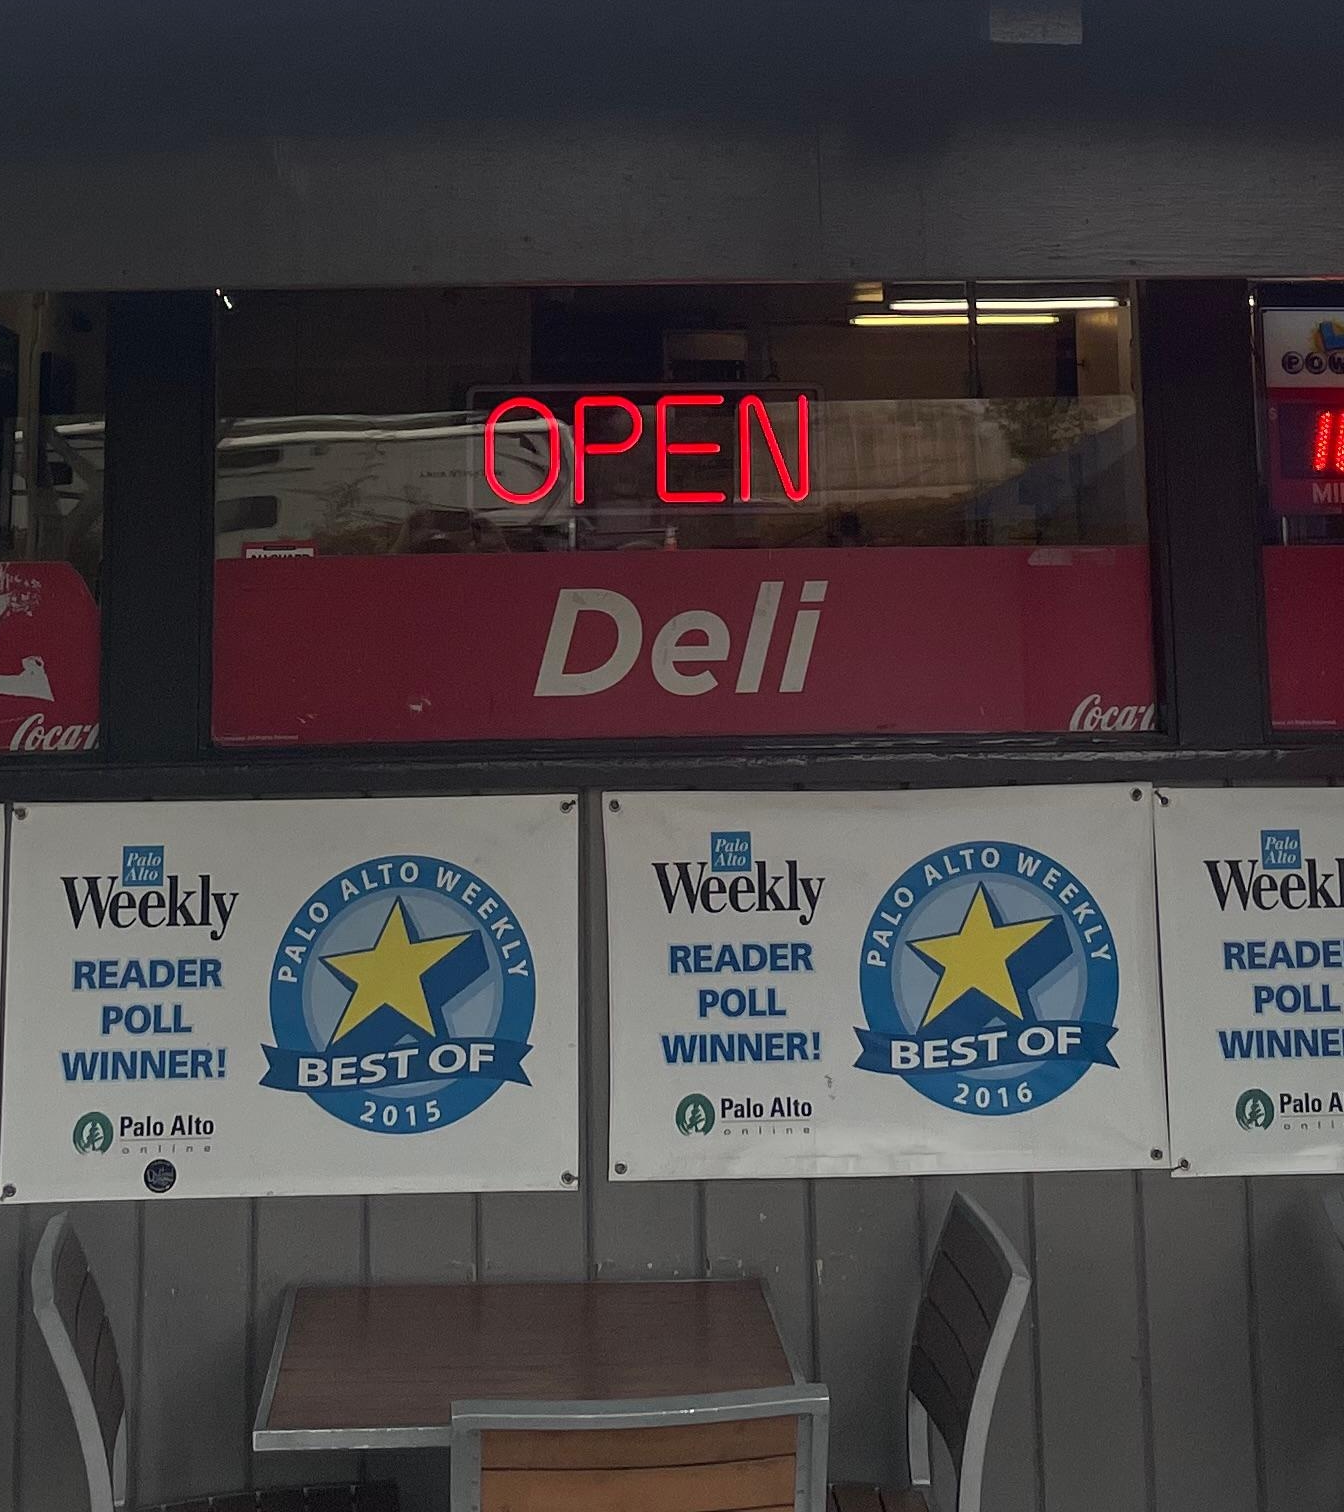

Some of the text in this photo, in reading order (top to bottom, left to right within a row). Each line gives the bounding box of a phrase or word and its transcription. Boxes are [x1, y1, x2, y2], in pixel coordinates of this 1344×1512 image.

[484, 394, 809, 506] OPEN
[533, 580, 829, 698] Deli
[715, 838, 749, 852] Palo
[1265, 836, 1299, 850] Palo
[1265, 850, 1297, 865] Alto
[125, 867, 158, 882] Alto
[126, 852, 162, 867] Palo
[715, 852, 747, 867] Alto
[60, 874, 239, 941] Weekly
[651, 860, 826, 926] Weekly
[867, 848, 1112, 967] PALO ALTO WEEKLY
[277, 861, 529, 983] PALO ALTO WEEKLY
[73, 958, 223, 989] READER
[669, 943, 814, 974] READER
[699, 988, 787, 1018] POLL
[1253, 983, 1341, 1014] POLL
[101, 1004, 193, 1035] POLL
[661, 1031, 821, 1064] WINNER!
[891, 1026, 1082, 1069] BEST OF
[61, 1048, 226, 1081] WINNER!
[297, 1043, 495, 1087] BEST OF
[720, 1096, 813, 1119] Palo Alto
[953, 1082, 1033, 1108] 2016
[1279, 1092, 1323, 1113] Palo
[119, 1115, 214, 1137] Palo Alto
[359, 1100, 441, 1127] 2015
